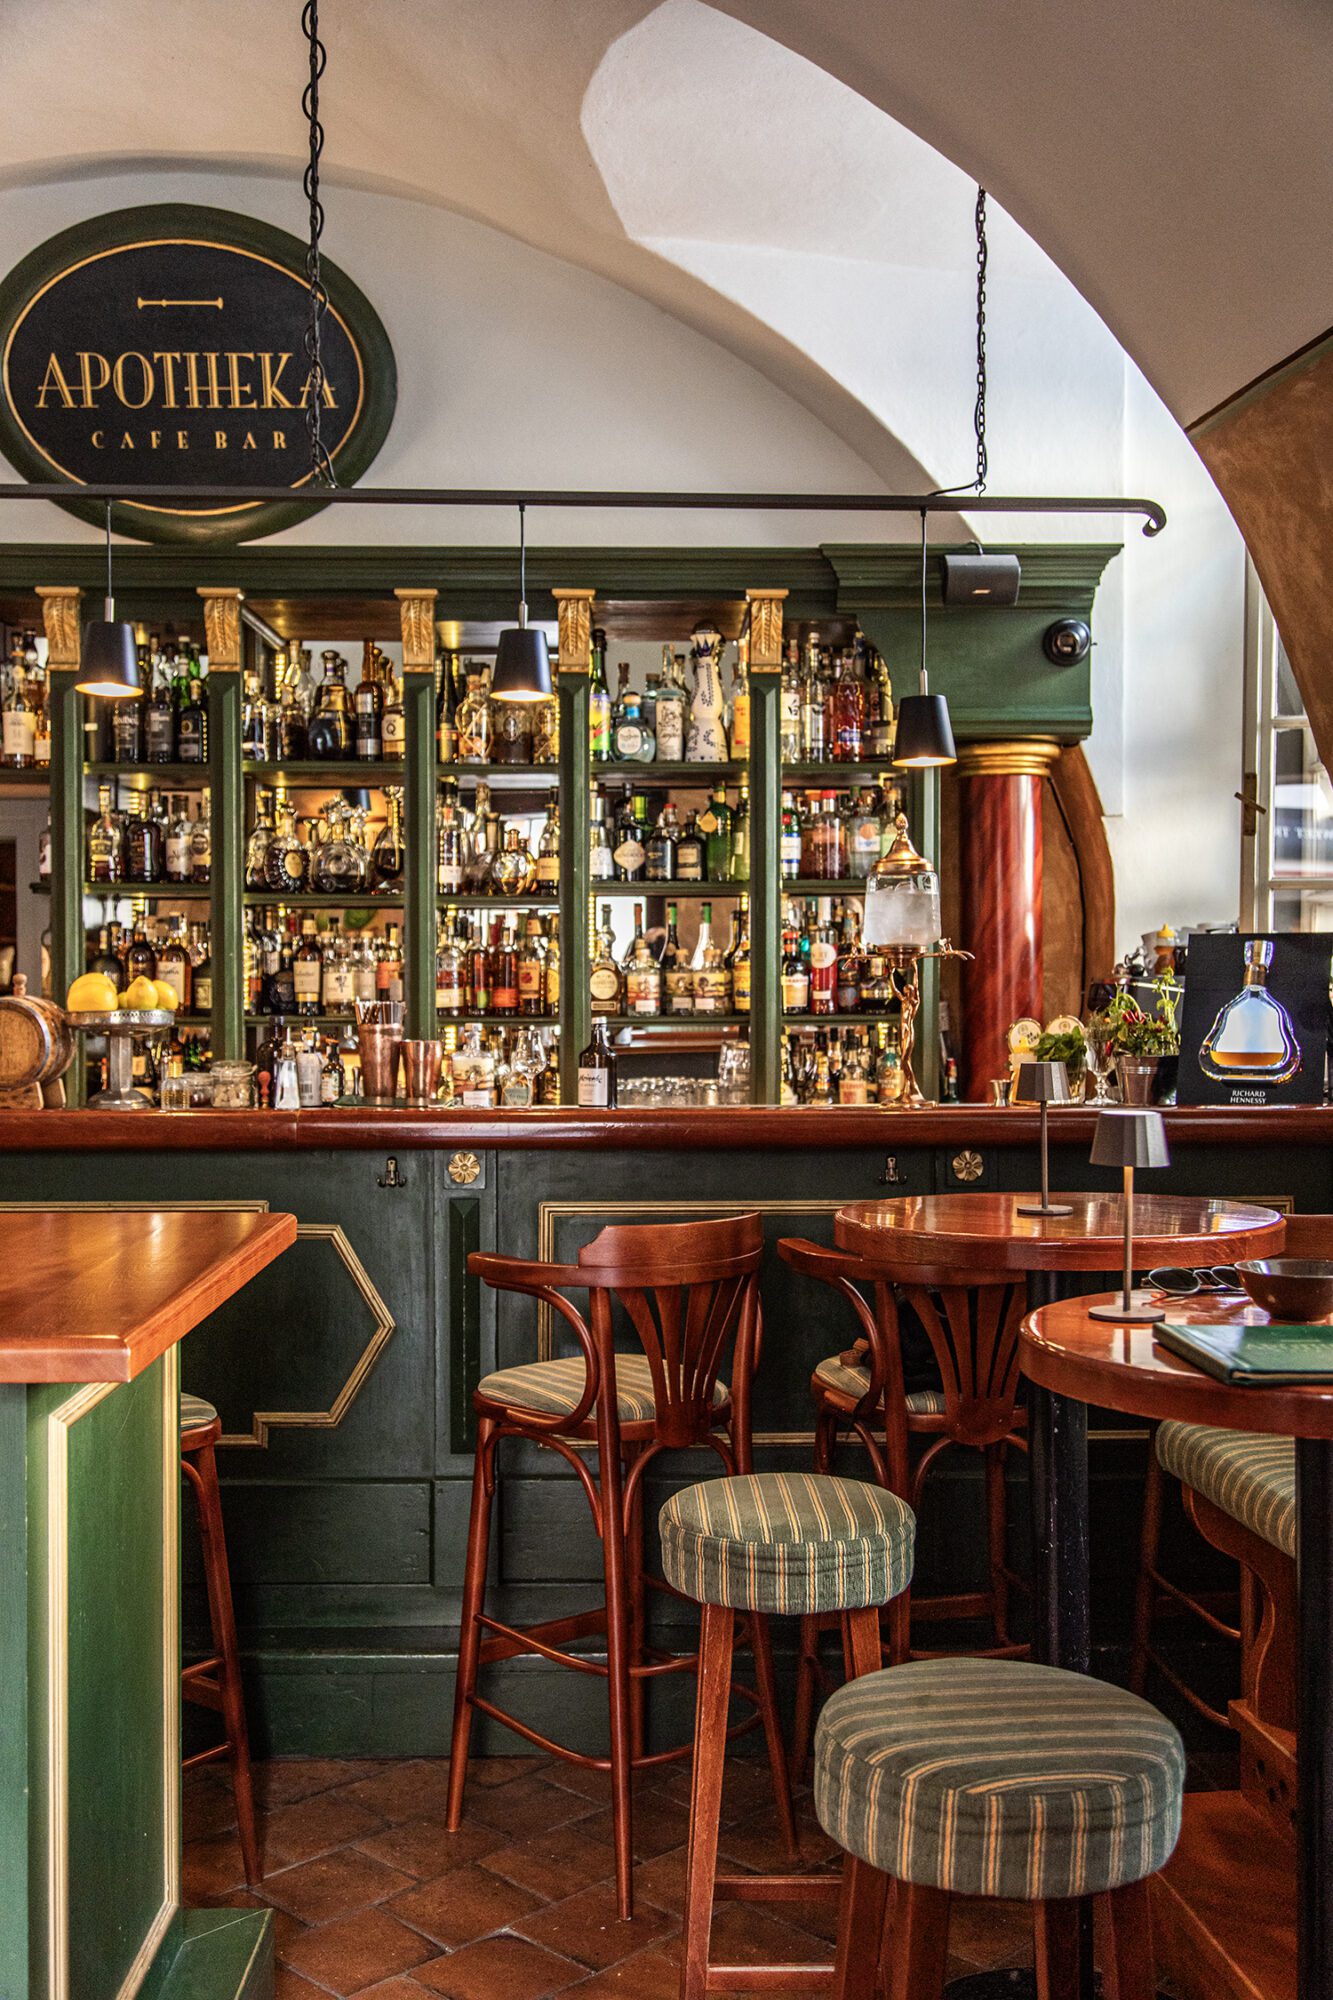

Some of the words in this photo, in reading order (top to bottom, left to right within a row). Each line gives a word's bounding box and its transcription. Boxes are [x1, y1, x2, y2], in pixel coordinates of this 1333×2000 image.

[35, 351, 339, 409] APOTHEKA
[91, 431, 190, 450] CAFE
[215, 431, 288, 450] BAR
[1232, 1089, 1265, 1097] RICHARD
[1230, 1096, 1266, 1104] HENNESSY
